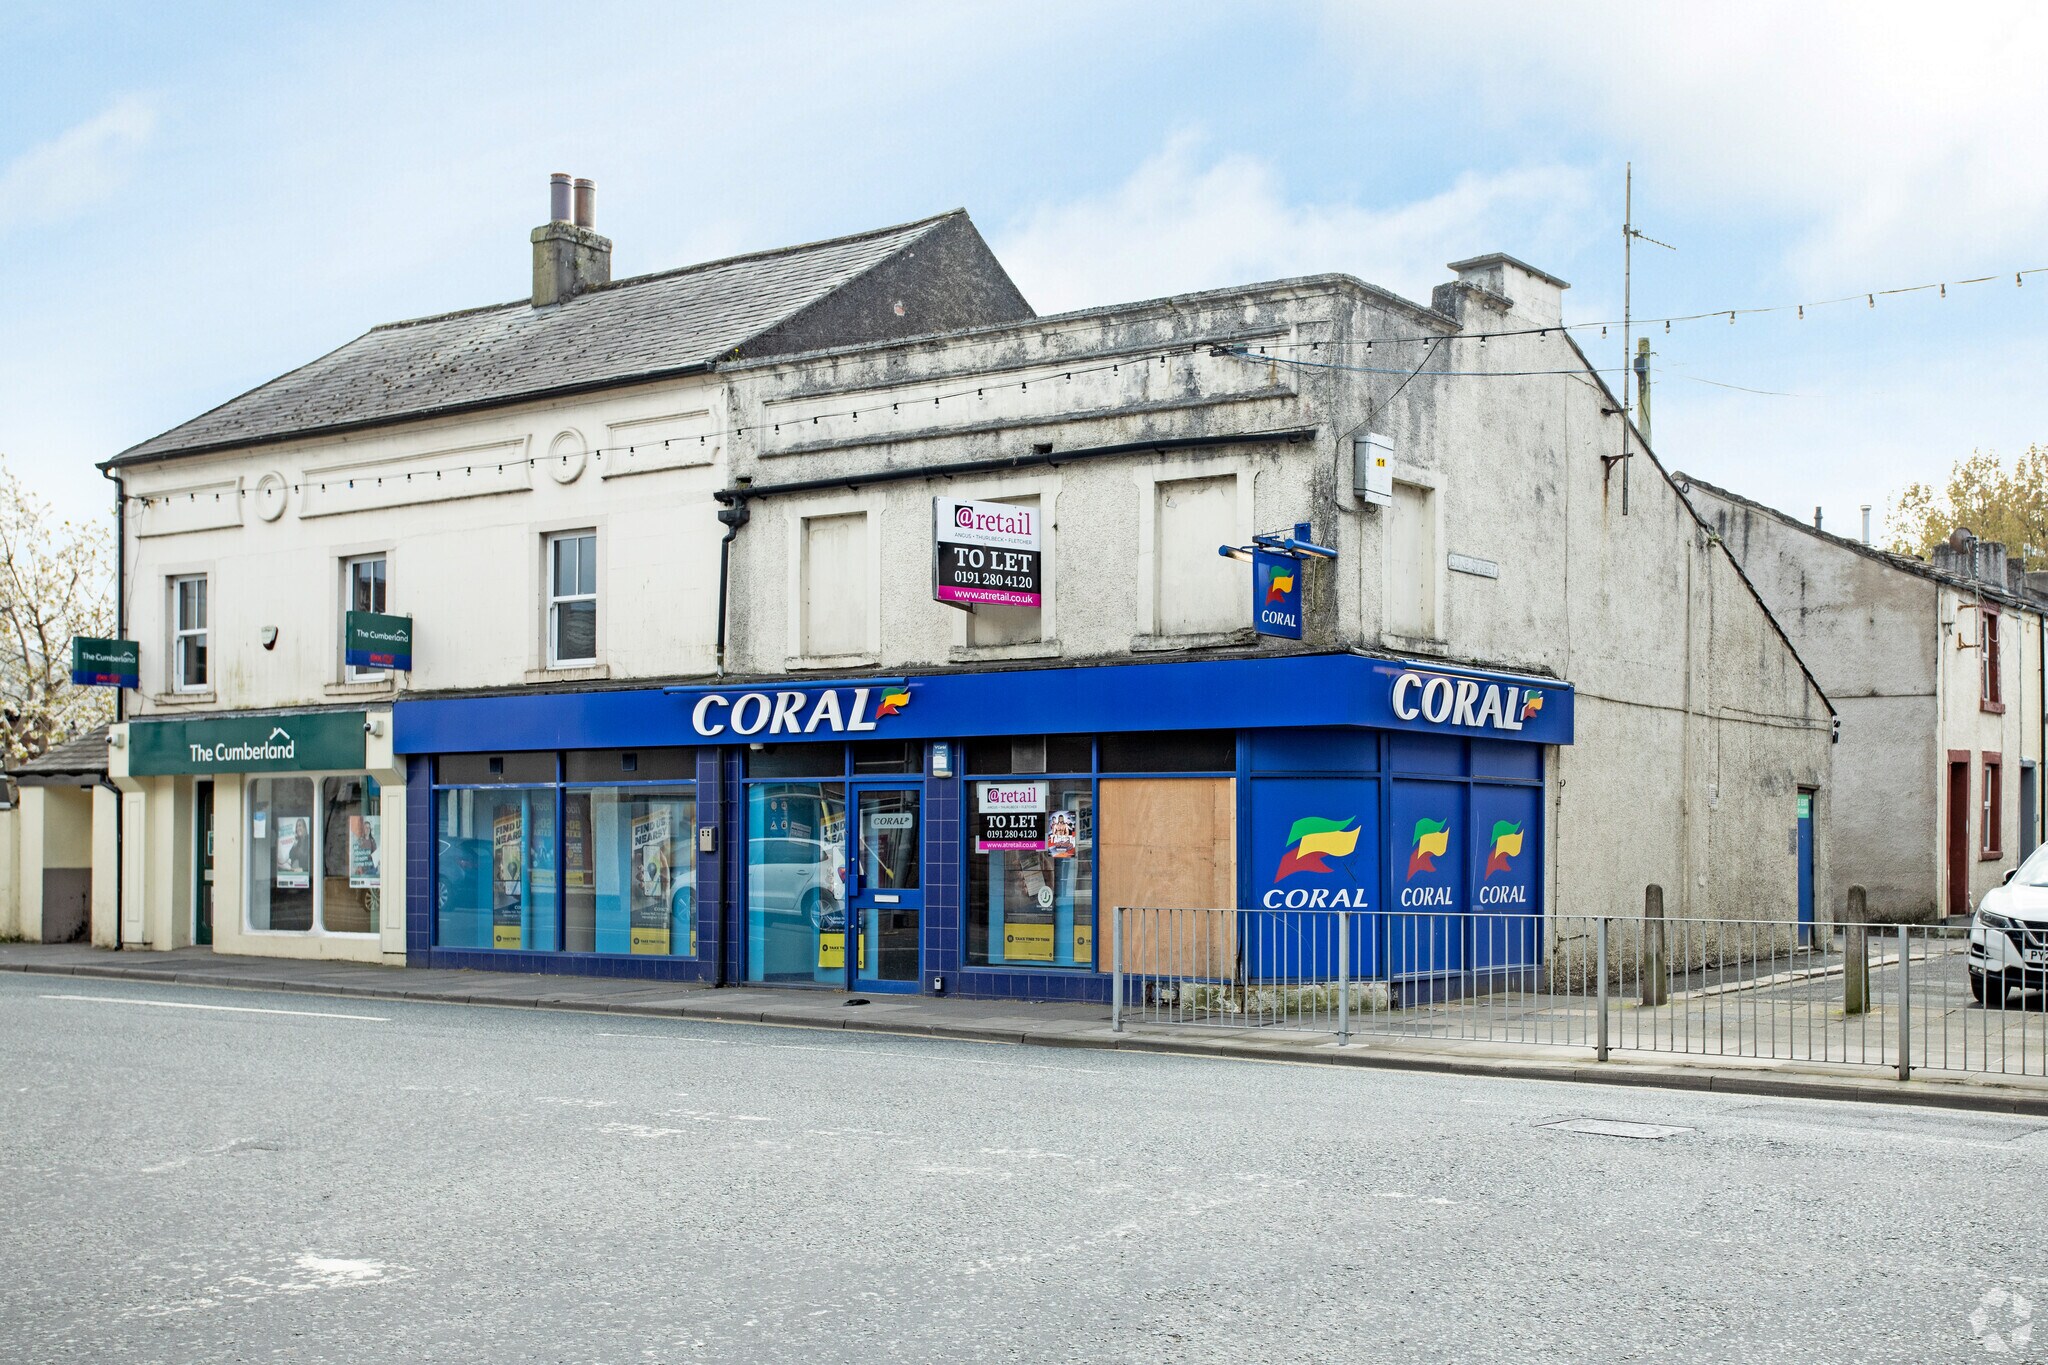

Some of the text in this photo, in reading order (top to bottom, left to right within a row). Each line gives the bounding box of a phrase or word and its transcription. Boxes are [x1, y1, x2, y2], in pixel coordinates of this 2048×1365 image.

[1008, 537, 1032, 545] FLETCHER
[954, 547, 1032, 573] TO LET
[954, 571, 1032, 589] 0191 280 4120
[954, 590, 1033, 604] www.atretail.co.uk
[1261, 610, 1297, 627] CORAL
[356, 629, 409, 642] The Cumberland
[82, 652, 136, 663] The Cumberland
[1392, 673, 1524, 731] CORAL
[692, 688, 877, 736] CORAL
[189, 740, 295, 762] The Cumberland
[635, 816, 666, 836] FIND US
[824, 820, 845, 836] FIND
[874, 817, 905, 825] CORAL
[987, 815, 1037, 828] TO LET
[824, 833, 845, 844] NEA
[987, 830, 1037, 839] 0191 280 4120
[1263, 889, 1368, 908] CORAL
[1401, 887, 1453, 906] CORAL
[1479, 886, 1526, 904] CORAL
[2031, 950, 2048, 961] PY
